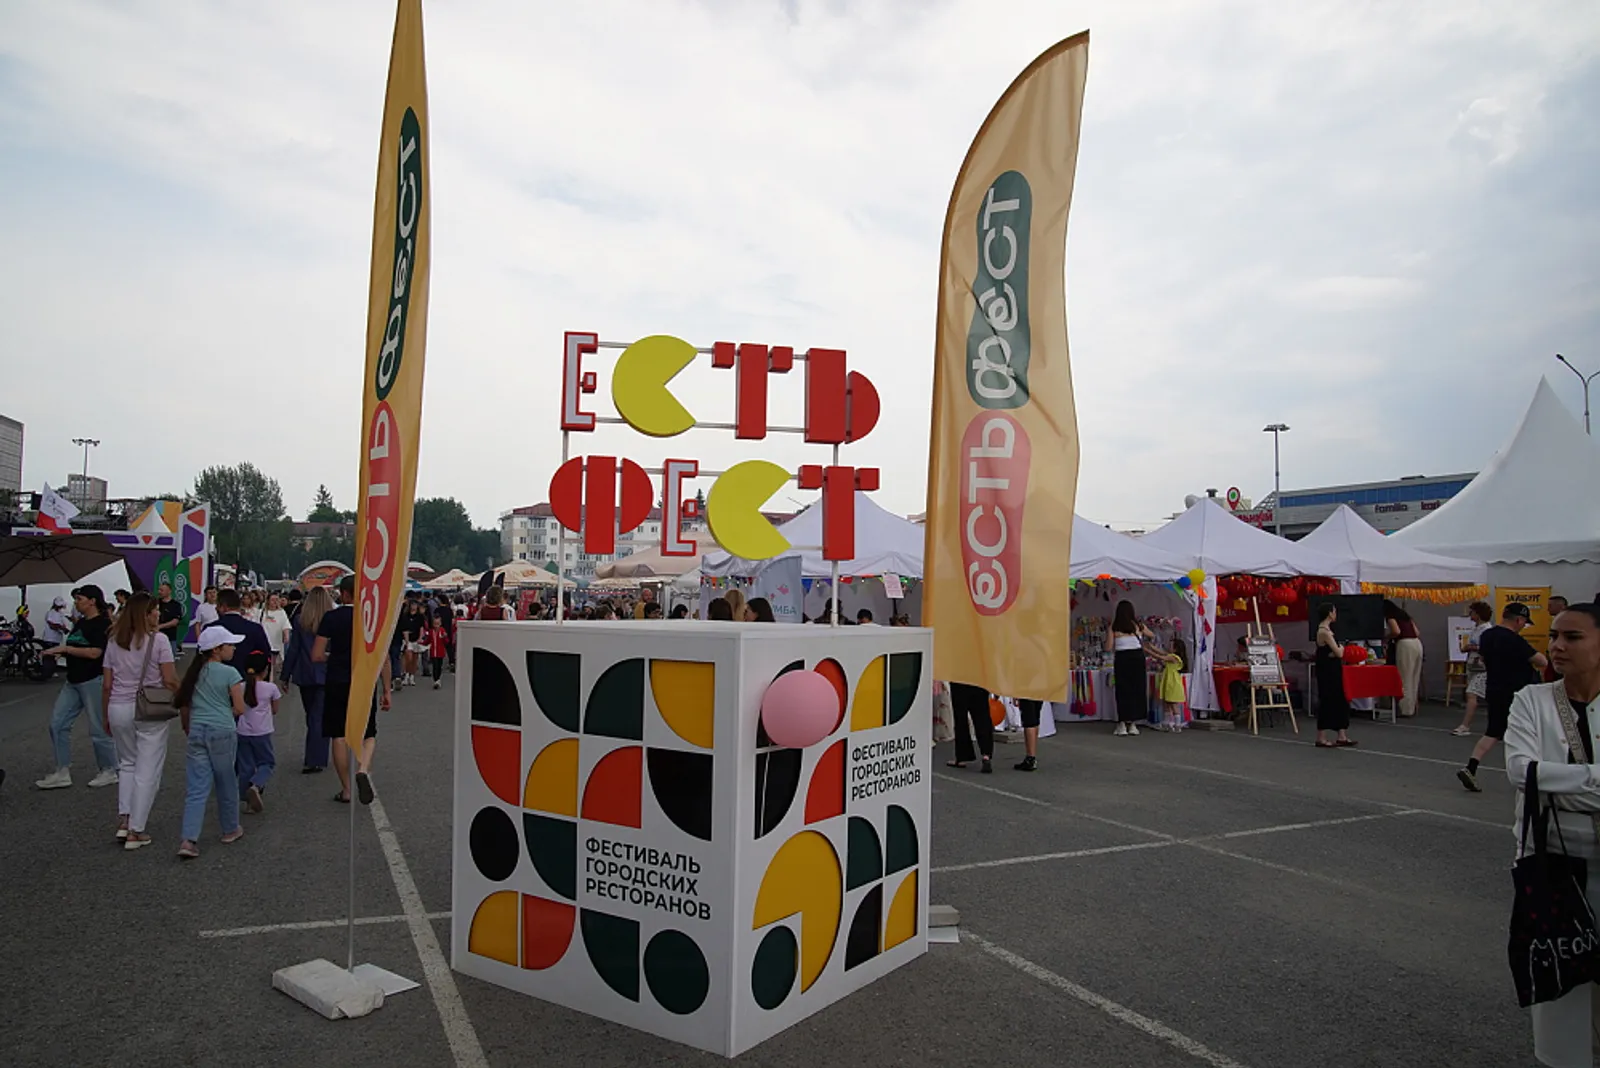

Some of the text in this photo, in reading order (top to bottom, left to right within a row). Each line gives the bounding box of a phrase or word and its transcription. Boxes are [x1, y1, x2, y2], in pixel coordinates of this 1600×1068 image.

[561, 331, 880, 445] ЕСТЬ
[549, 455, 880, 561] ФЕСТ
[852, 736, 916, 762] ФЕСТИВАЛЬ
[852, 753, 915, 782] ГОРОДСКИХ
[852, 769, 921, 802] РЕСТОРАНОВ
[585, 837, 701, 874] ФЕСТИВАЛЬ
[586, 857, 698, 896] ГОРОДСКИХ
[586, 878, 711, 921] РЕСТОРАНОВ
